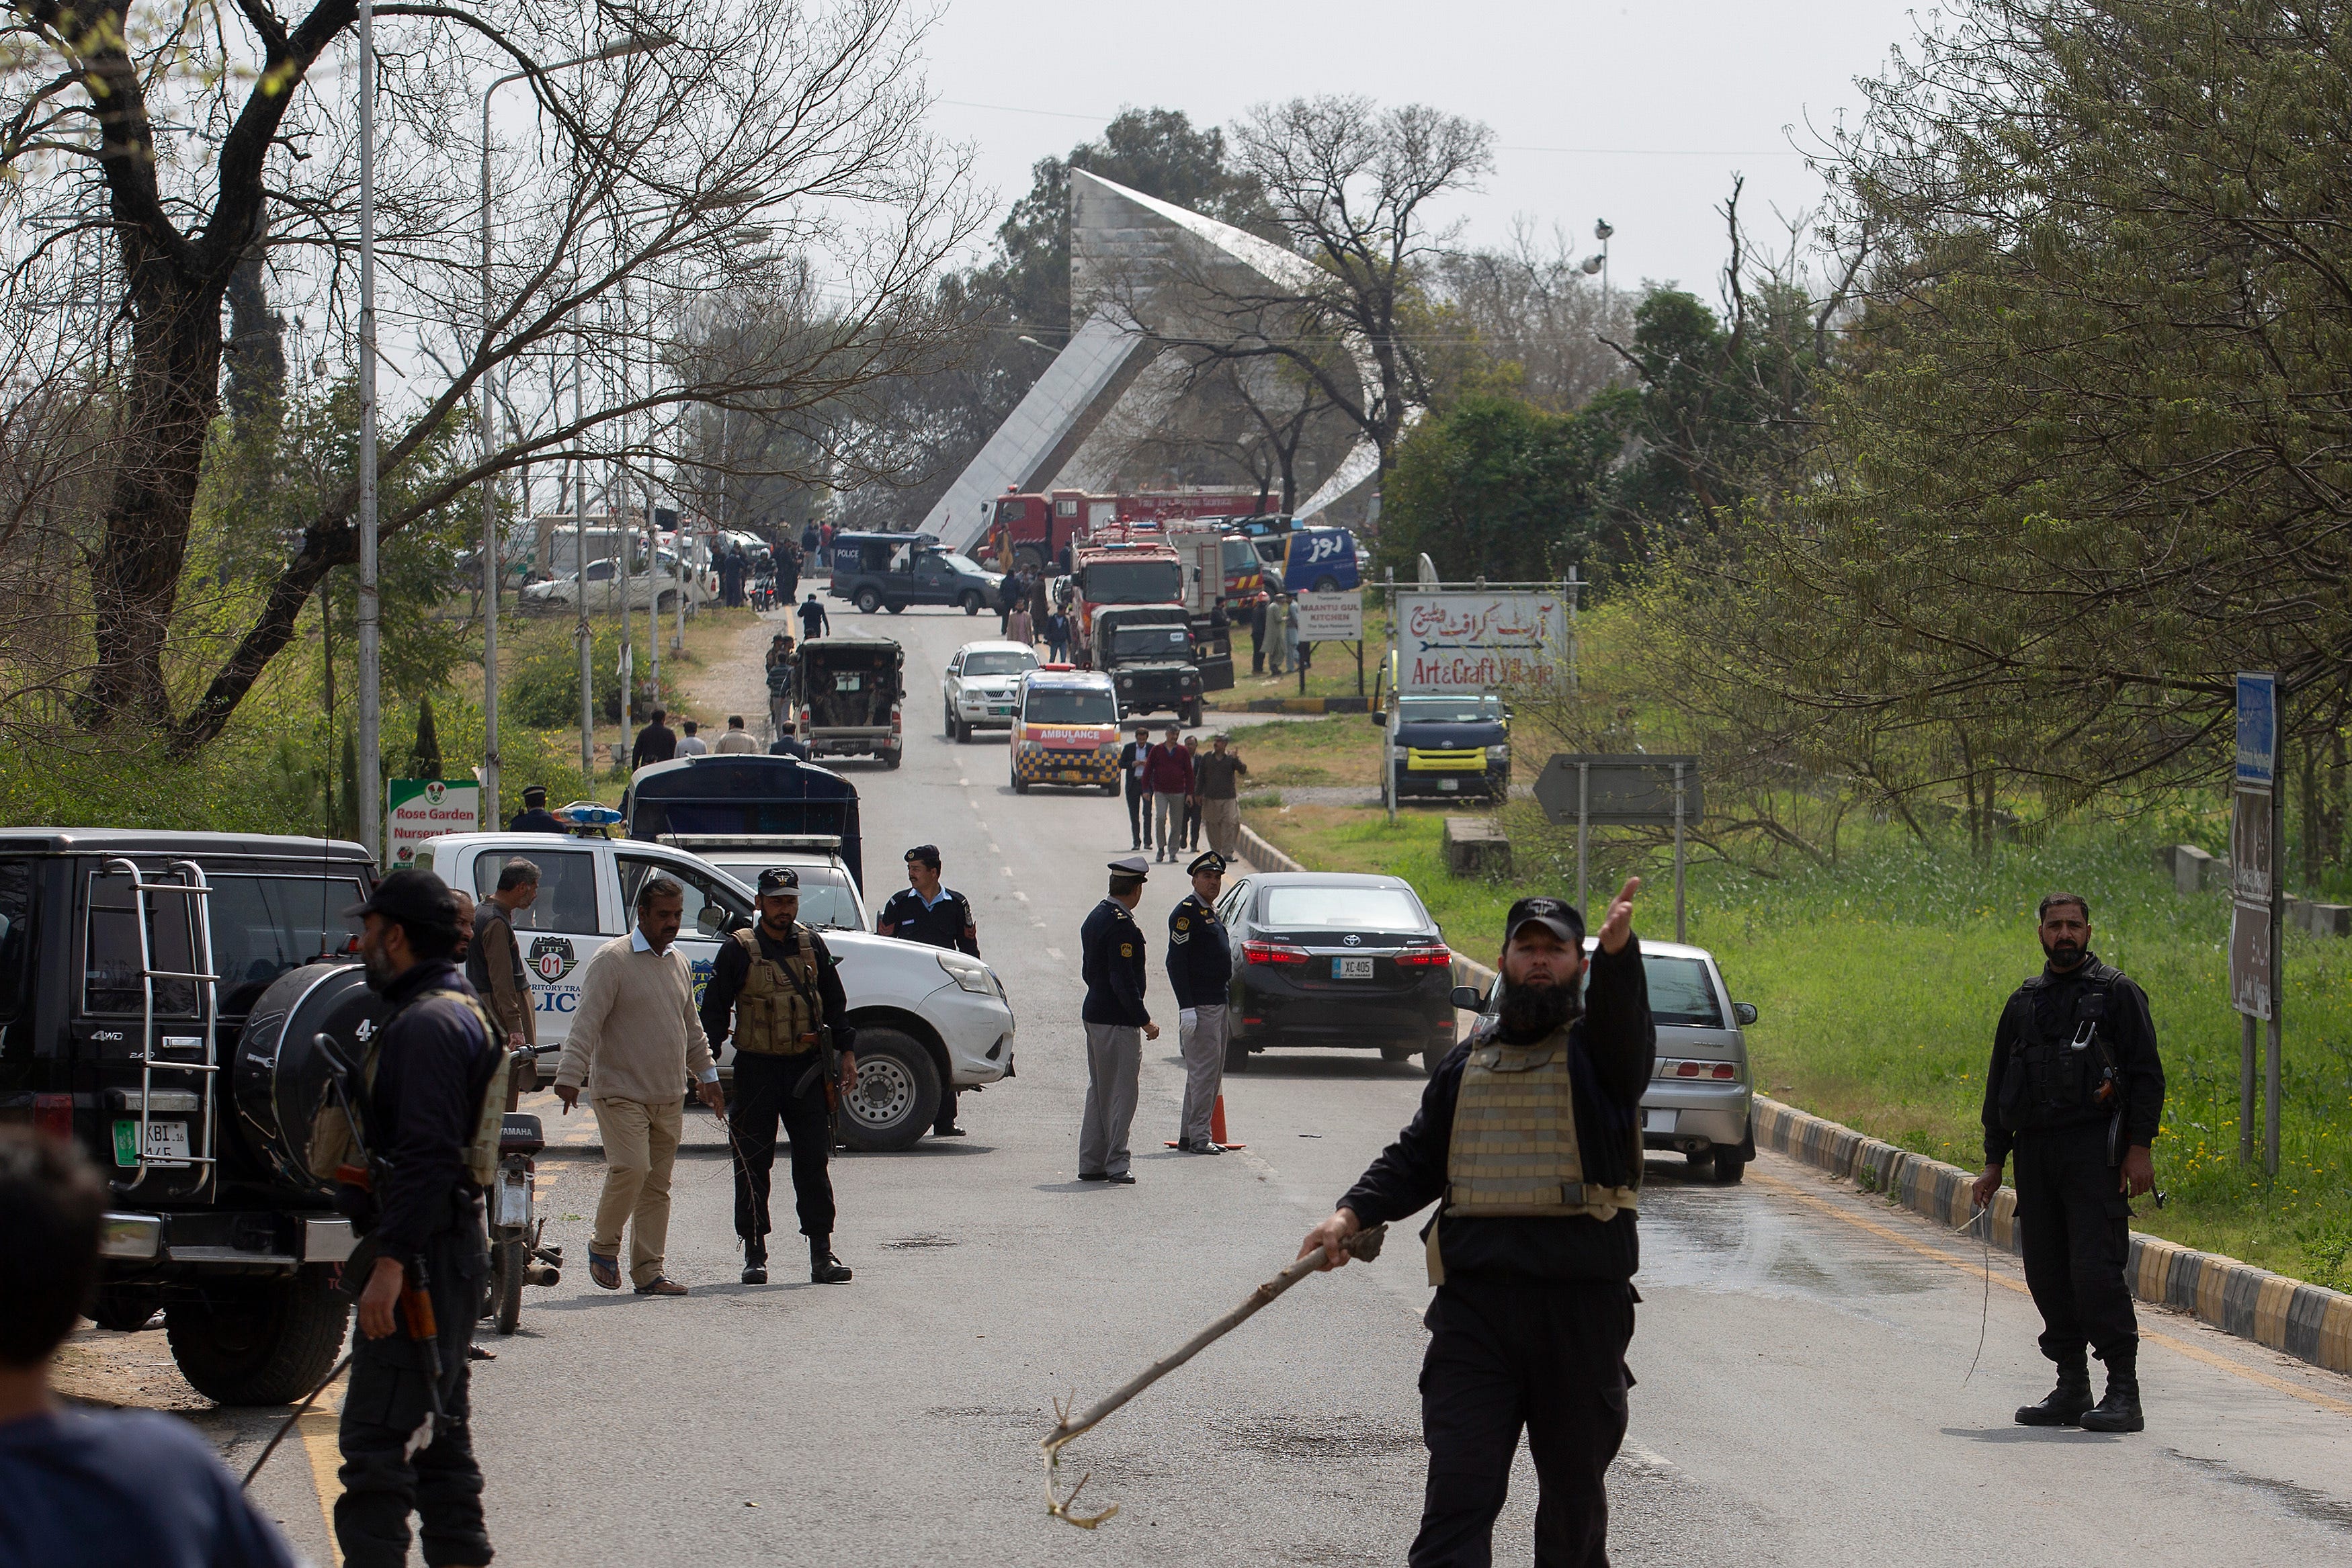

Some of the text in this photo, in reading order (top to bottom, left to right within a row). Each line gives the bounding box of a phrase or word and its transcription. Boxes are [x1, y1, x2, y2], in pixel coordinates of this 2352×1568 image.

[837, 549, 859, 558] POLICE
[1307, 535, 1343, 562] روز
[1041, 730, 1100, 739] AMBULANCE
[397, 808, 474, 820] Rose Garden
[542, 957, 560, 974] 01
[691, 972, 710, 981] IT
[91, 1030, 124, 1041] 4WD
[500, 1127, 533, 1136] YAMAHA
